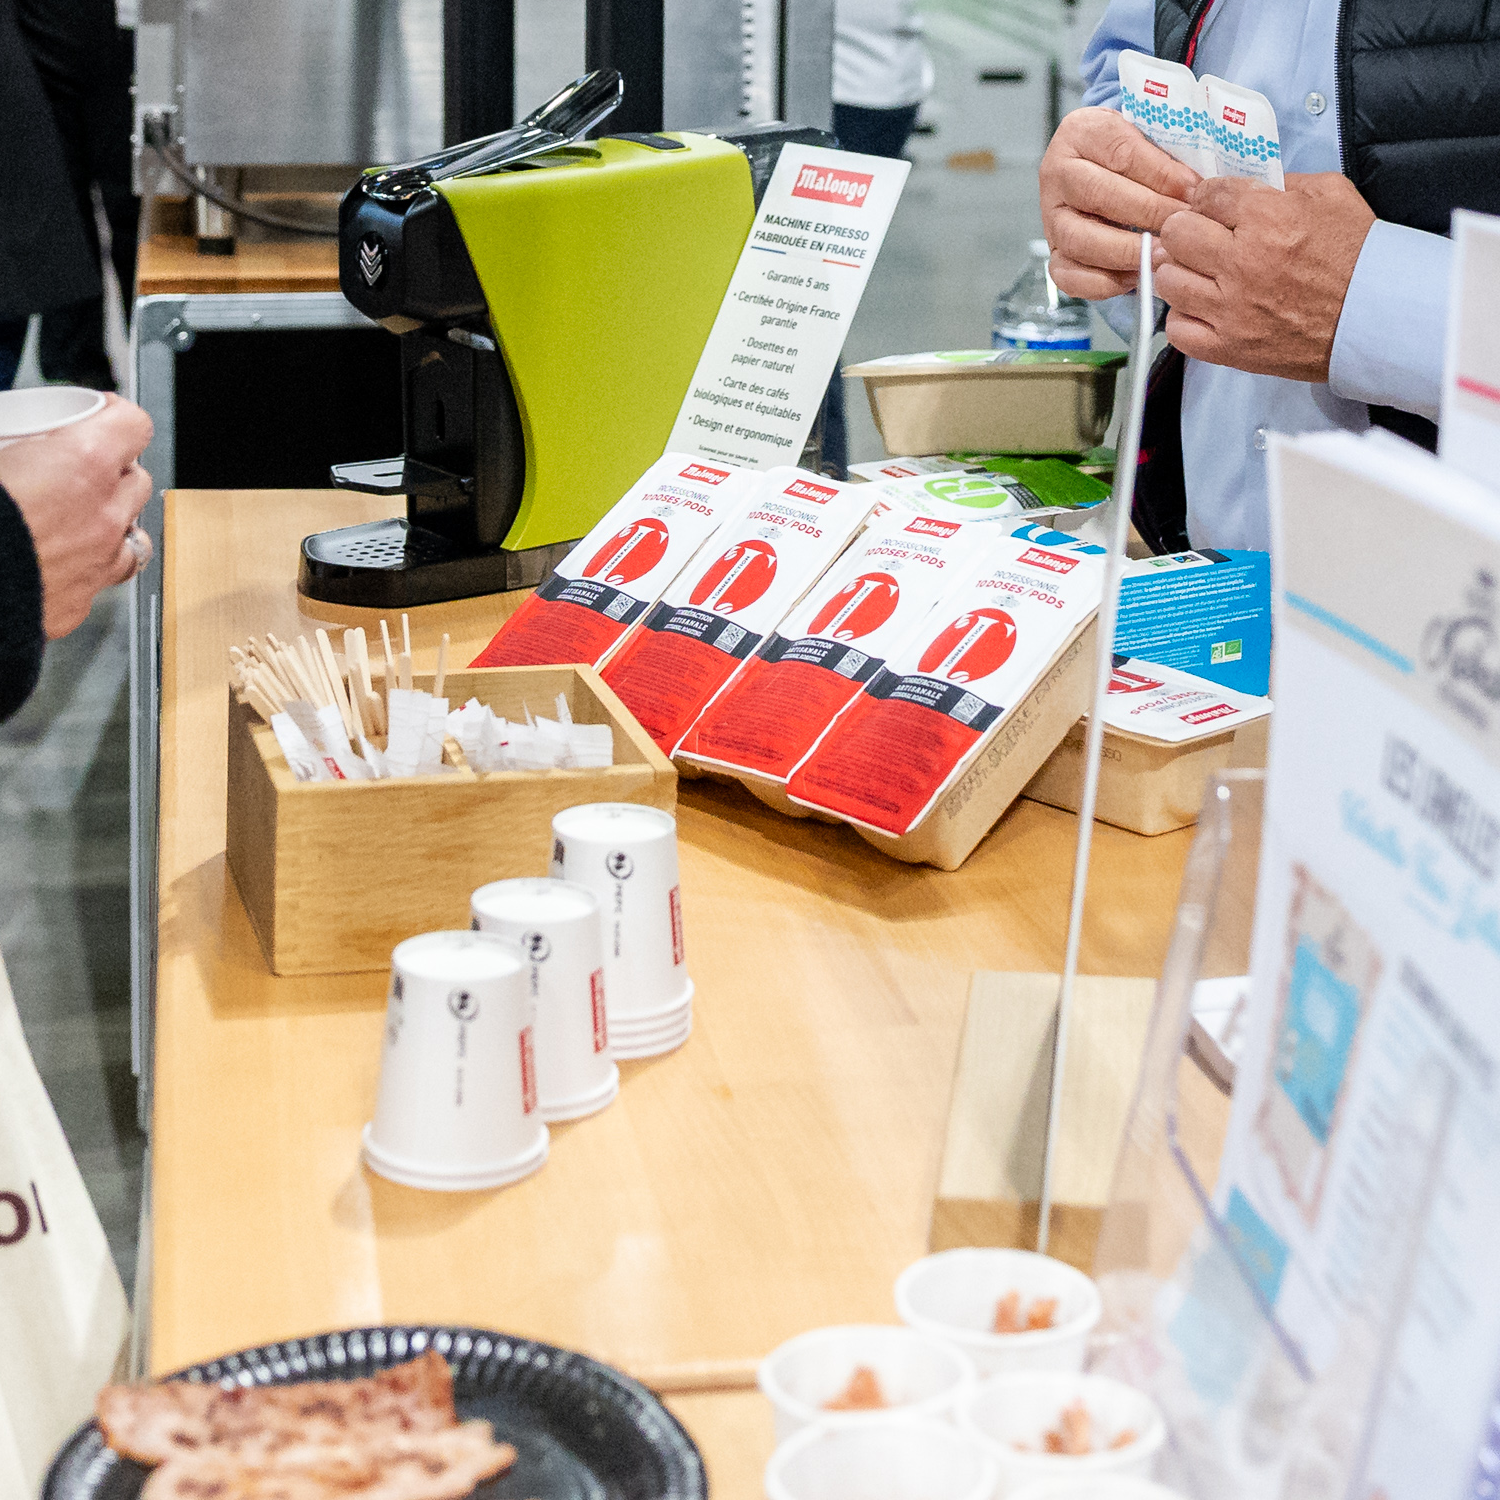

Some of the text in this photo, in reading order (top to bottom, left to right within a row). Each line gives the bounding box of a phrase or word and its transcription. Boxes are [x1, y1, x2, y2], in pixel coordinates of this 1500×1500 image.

[797, 168, 868, 202] Malongo
[764, 214, 870, 242] MACHINE EXPRESSO
[753, 230, 867, 259] FABRIQUÉE EN FRANCE
[767, 269, 830, 292] Garantie 5 ans
[738, 290, 841, 320] Certifiée Origine France
[760, 315, 798, 330] garantie
[747, 337, 798, 357] Dosettes en
[731, 353, 795, 374] papier naturel
[723, 376, 790, 401] Carte des cafés
[693, 388, 802, 422] biologiques et équitables
[693, 414, 793, 448] Design et ergonomique
[787, 480, 838, 504] Malongo
[909, 519, 957, 538] Malongo
[1019, 549, 1078, 574] Malongo
[993, 569, 1061, 595] PROFESSIONNEL
